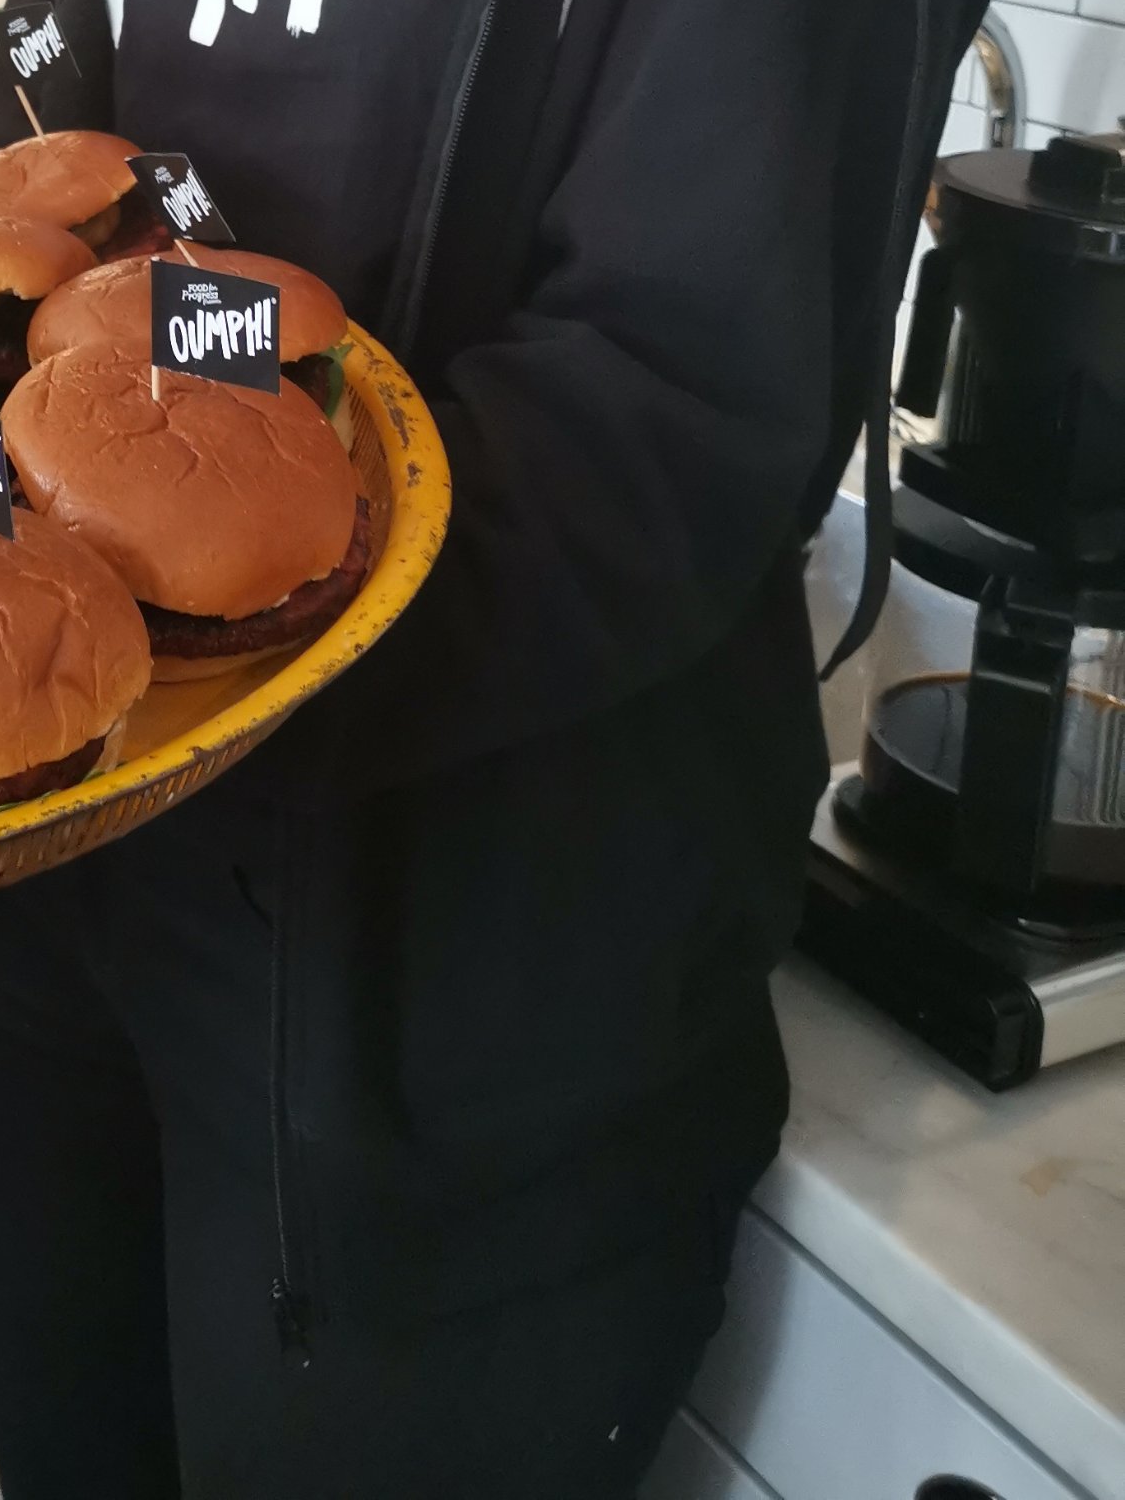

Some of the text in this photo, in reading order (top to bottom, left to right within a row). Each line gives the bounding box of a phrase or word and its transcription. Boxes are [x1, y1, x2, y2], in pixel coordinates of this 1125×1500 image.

[9, 13, 65, 78] OUMPH!
[162, 168, 212, 232] OUMPH!
[182, 290, 219, 302] Progress
[188, 283, 208, 293] FOOD
[169, 297, 272, 363] OUMPH!
